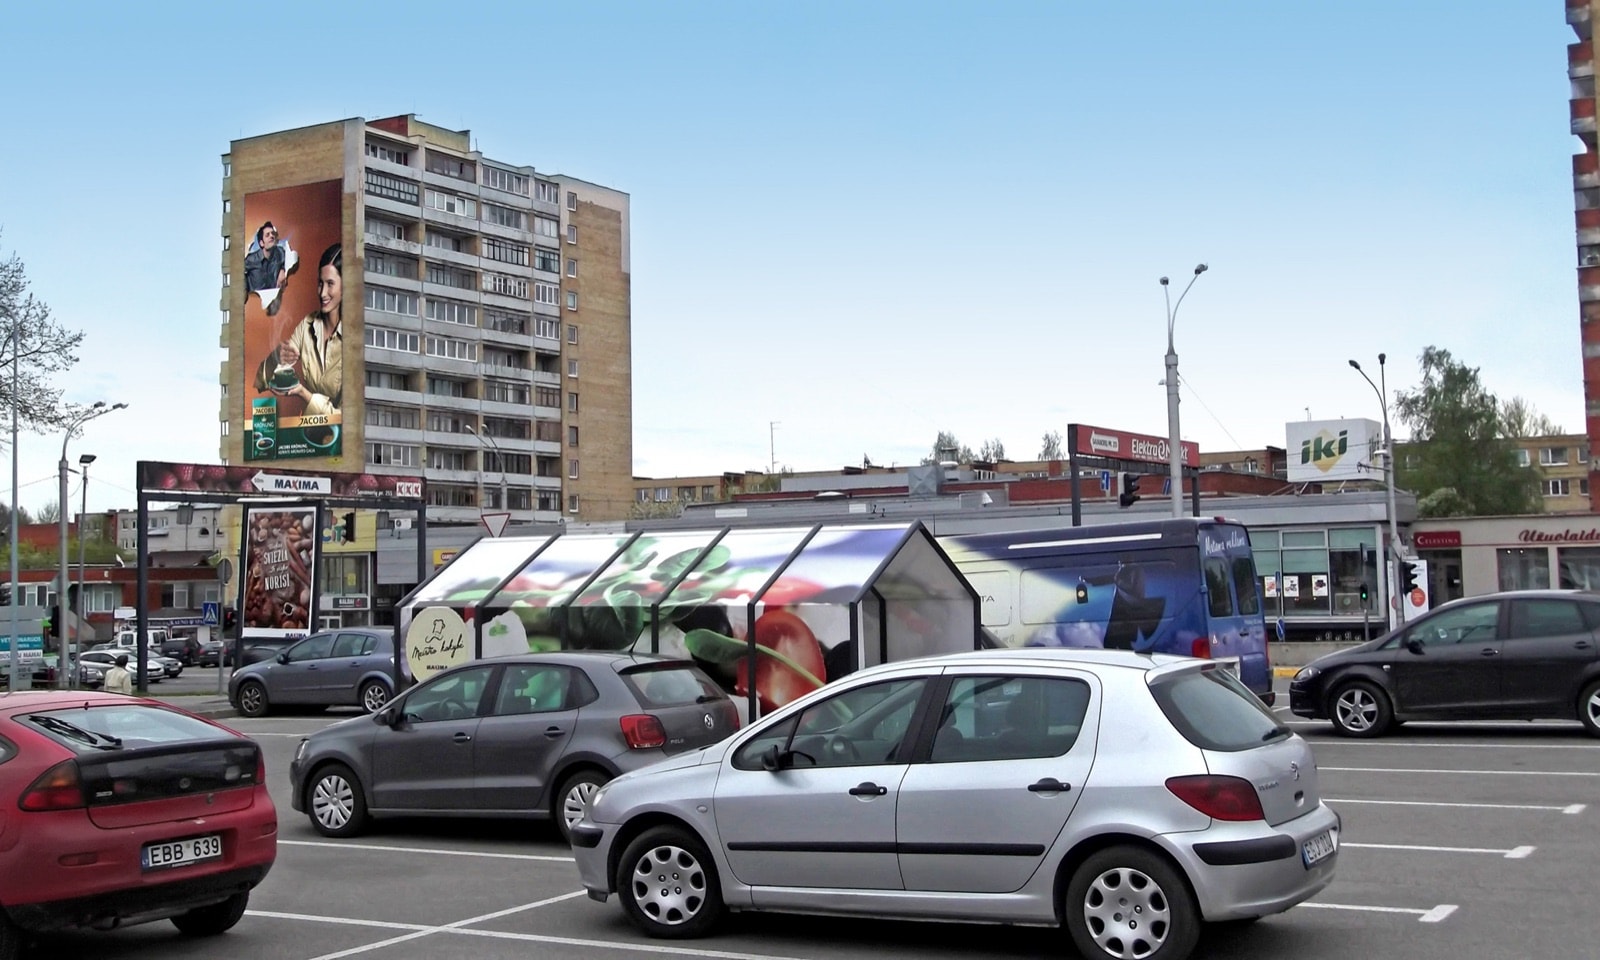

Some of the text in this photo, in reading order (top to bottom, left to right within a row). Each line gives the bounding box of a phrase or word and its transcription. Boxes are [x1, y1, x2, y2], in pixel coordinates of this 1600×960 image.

[299, 416, 329, 427] JACOBS
[1301, 430, 1348, 465] iki
[275, 479, 319, 490] MAXIMA
[151, 844, 184, 865] EBB
[193, 837, 220, 857] 639
